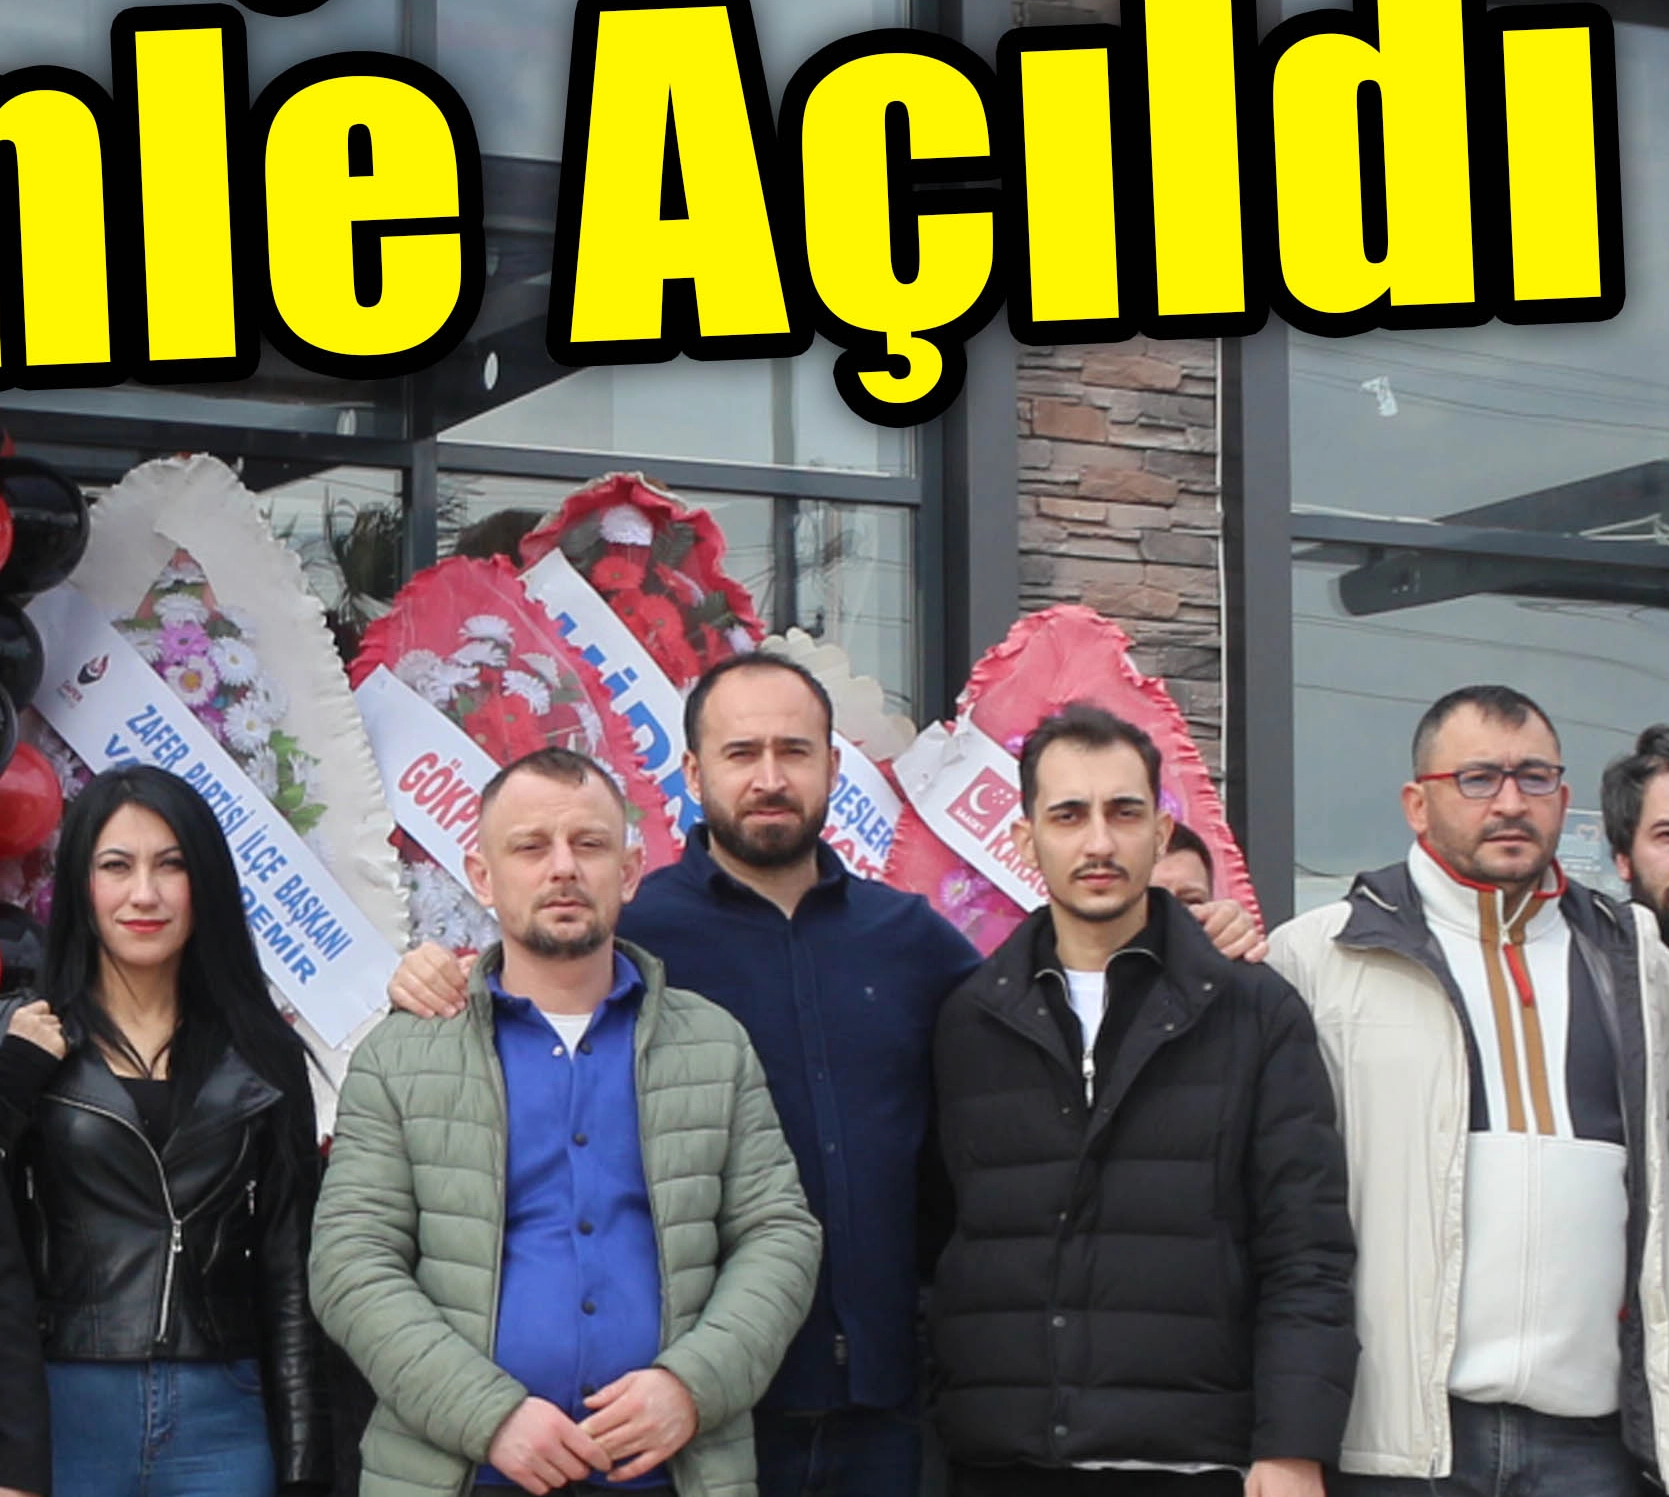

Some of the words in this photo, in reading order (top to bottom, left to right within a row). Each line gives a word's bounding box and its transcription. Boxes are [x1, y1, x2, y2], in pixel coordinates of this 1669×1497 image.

[124, 703, 191, 770] ZAFER
[235, 823, 289, 884] İLÇE
[273, 873, 354, 962] BAŞKANI
